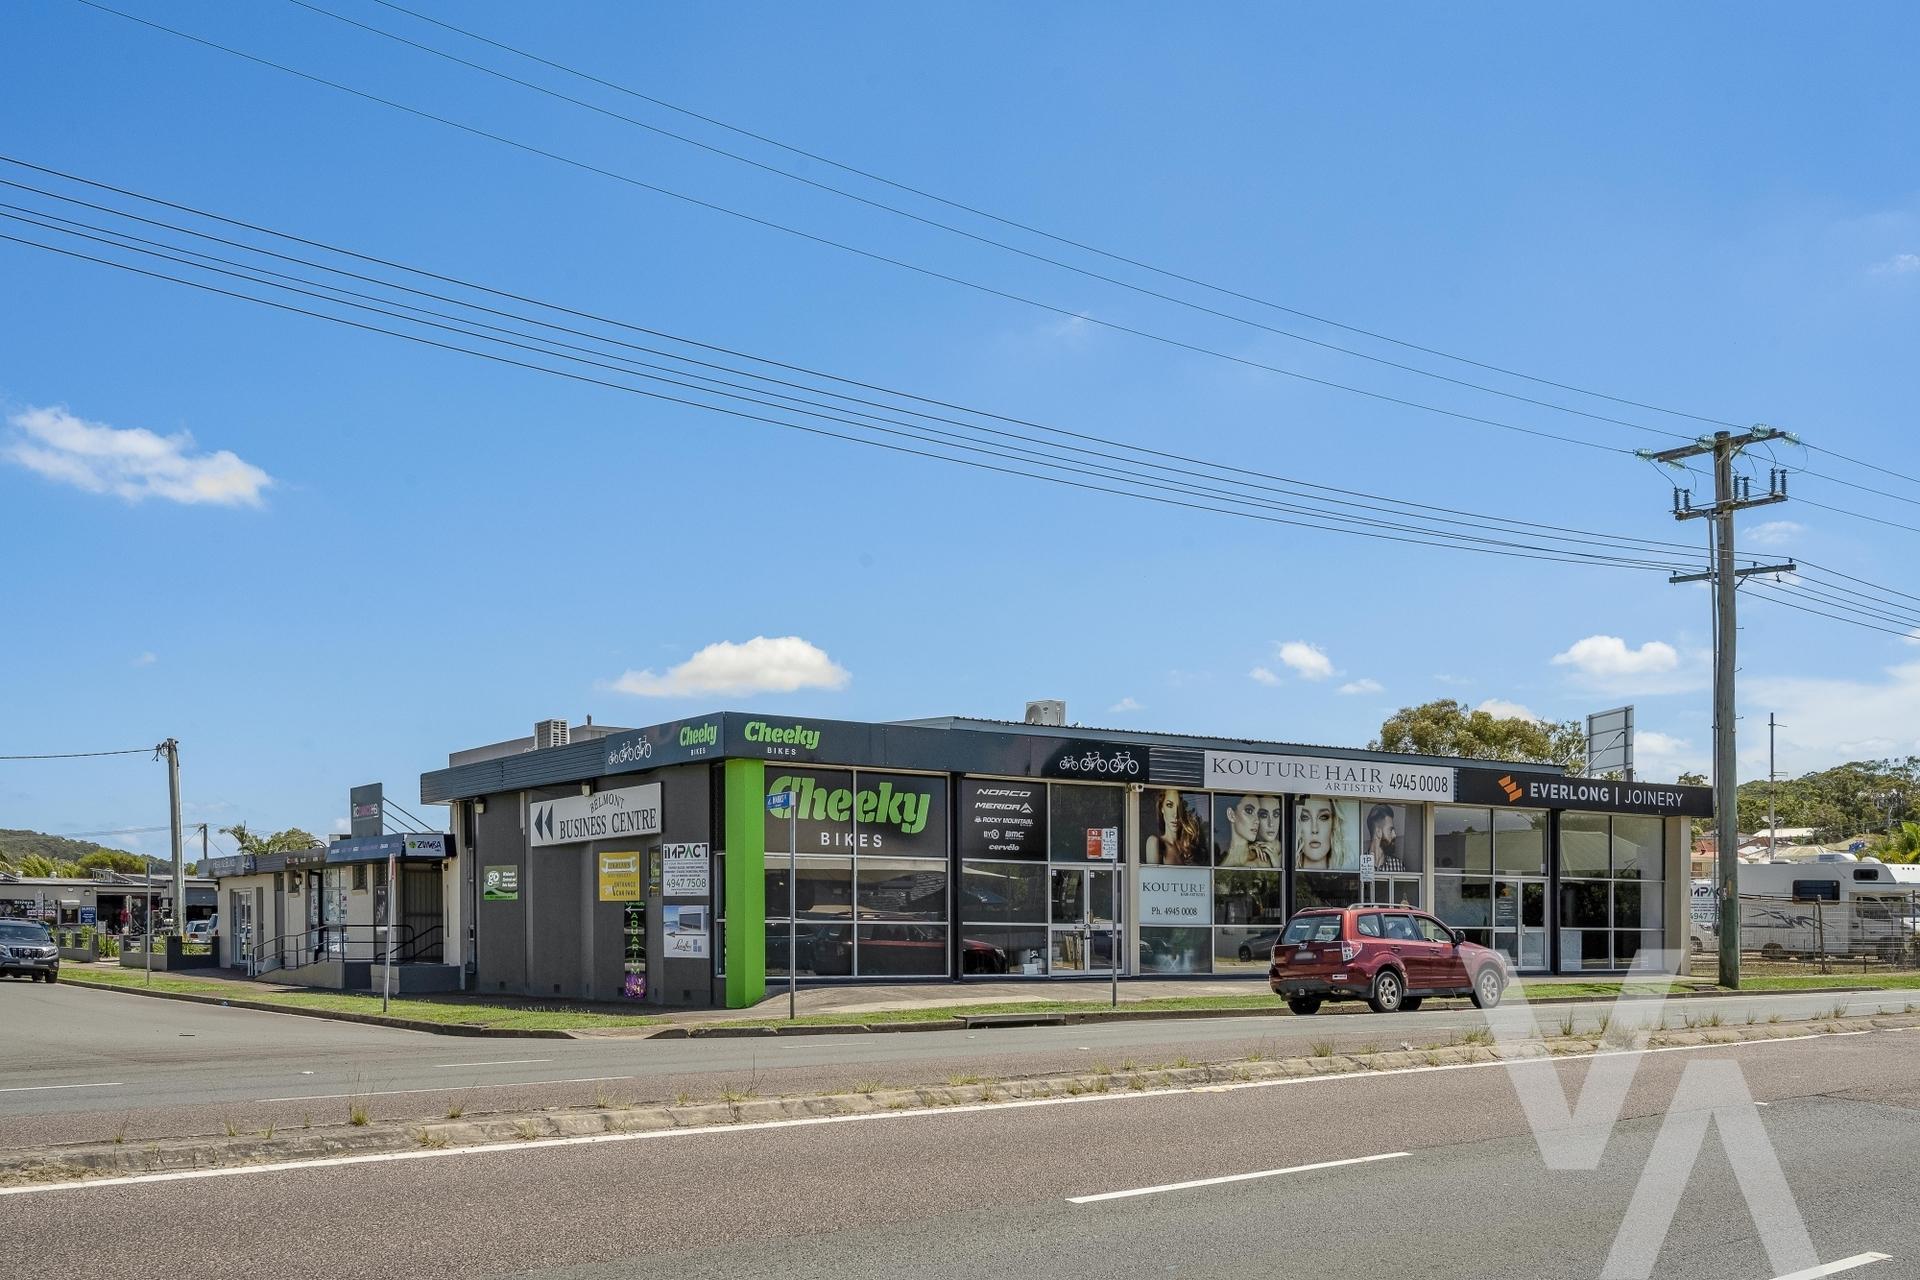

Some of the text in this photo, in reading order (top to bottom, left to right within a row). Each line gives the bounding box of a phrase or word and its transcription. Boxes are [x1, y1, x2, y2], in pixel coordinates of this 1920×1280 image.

[680, 723, 718, 746] Cheeky
[744, 721, 820, 750] Cheeky
[690, 747, 706, 756] BIKES
[767, 747, 797, 756] BIKES
[1212, 758, 1449, 792] KOUTURE HAIR 4945 0008
[976, 788, 1032, 797] NORCO
[1325, 782, 1384, 794] ARTISTRY
[1530, 782, 1684, 807] EVERLONG JOINERY
[590, 793, 625, 814] BELMONT
[768, 775, 931, 834] Cheeky
[975, 802, 1021, 811] MERIDA
[559, 808, 657, 839] BUSINESS CENTRE
[820, 832, 882, 848] BIKES
[1005, 830, 1024, 838] BMC
[988, 843, 1020, 851] cervélo
[666, 878, 707, 888] 4947 7508
[1142, 882, 1206, 893] KOUTURE
[1151, 906, 1198, 916] Ph. 4945 0008
[631, 912, 641, 975] AQUARIUM
